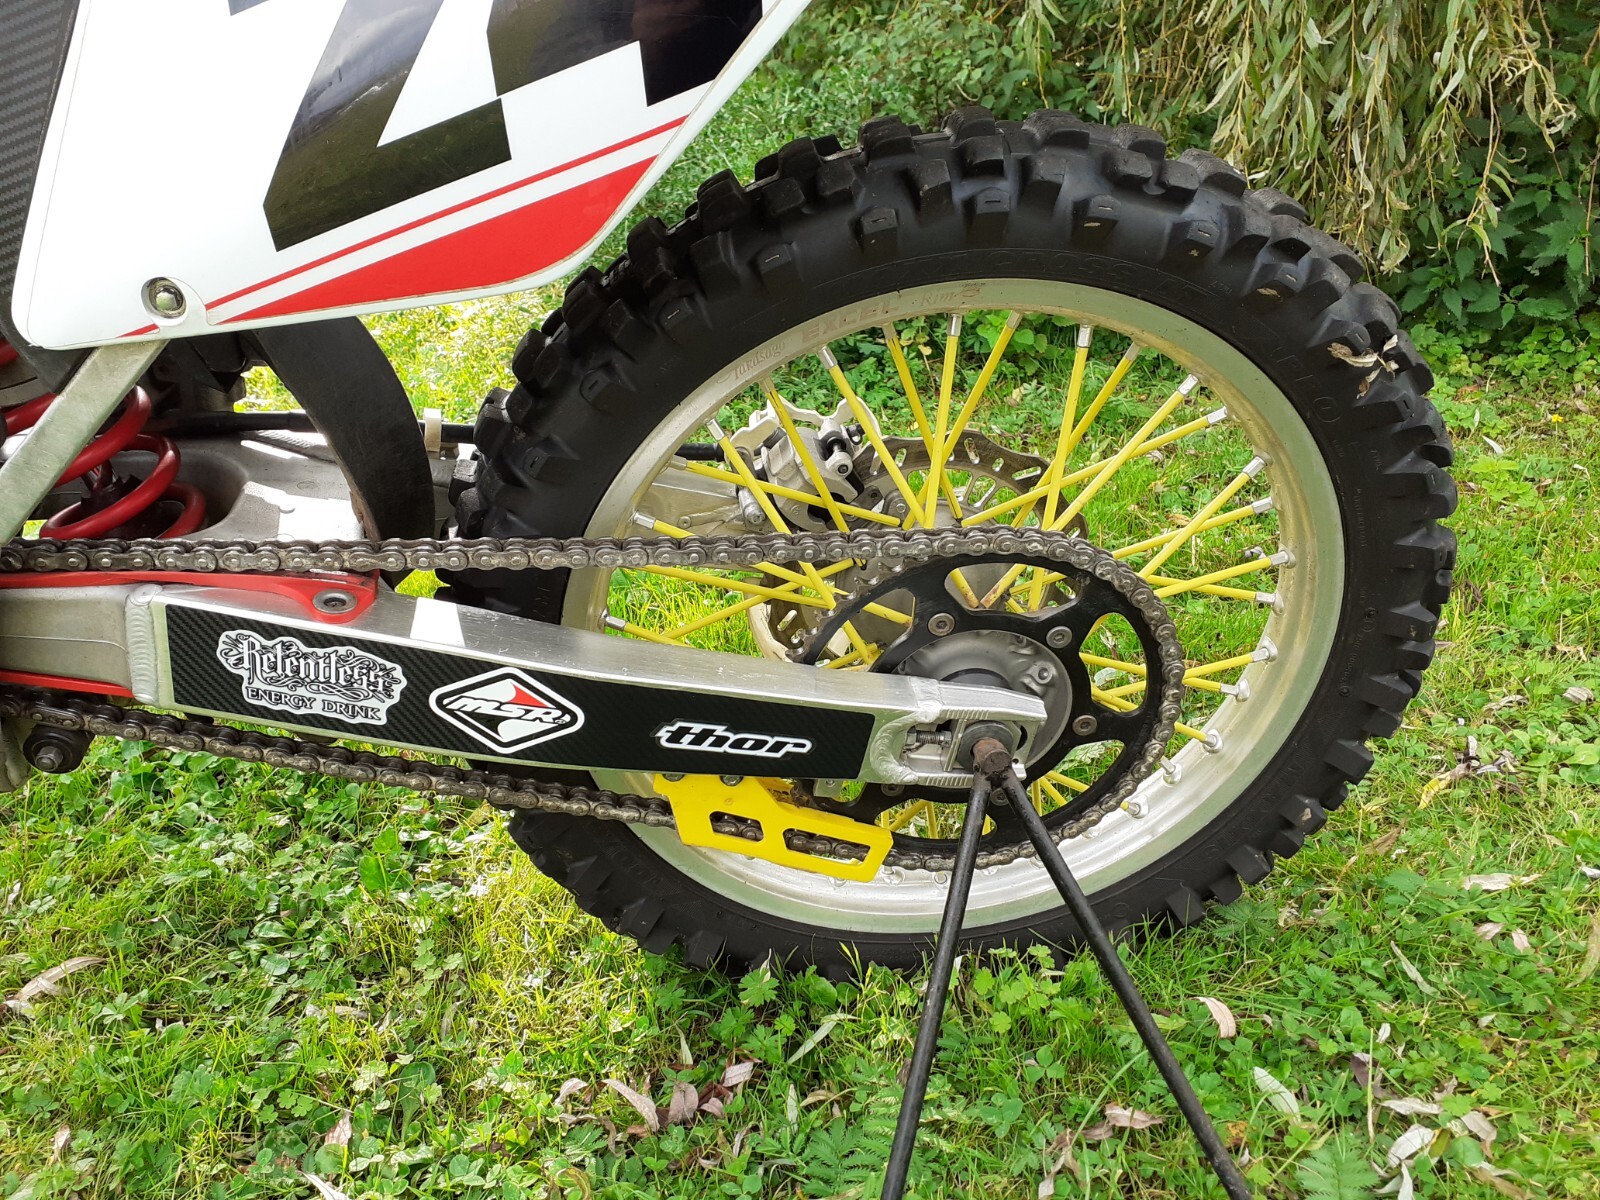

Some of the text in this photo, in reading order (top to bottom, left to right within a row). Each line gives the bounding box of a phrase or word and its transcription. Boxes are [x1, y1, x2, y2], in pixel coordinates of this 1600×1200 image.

[801, 302, 900, 344] EXCEL
[216, 633, 402, 703] Relentless
[246, 686, 382, 721] ENERGY DRINK
[655, 721, 813, 758] thor
